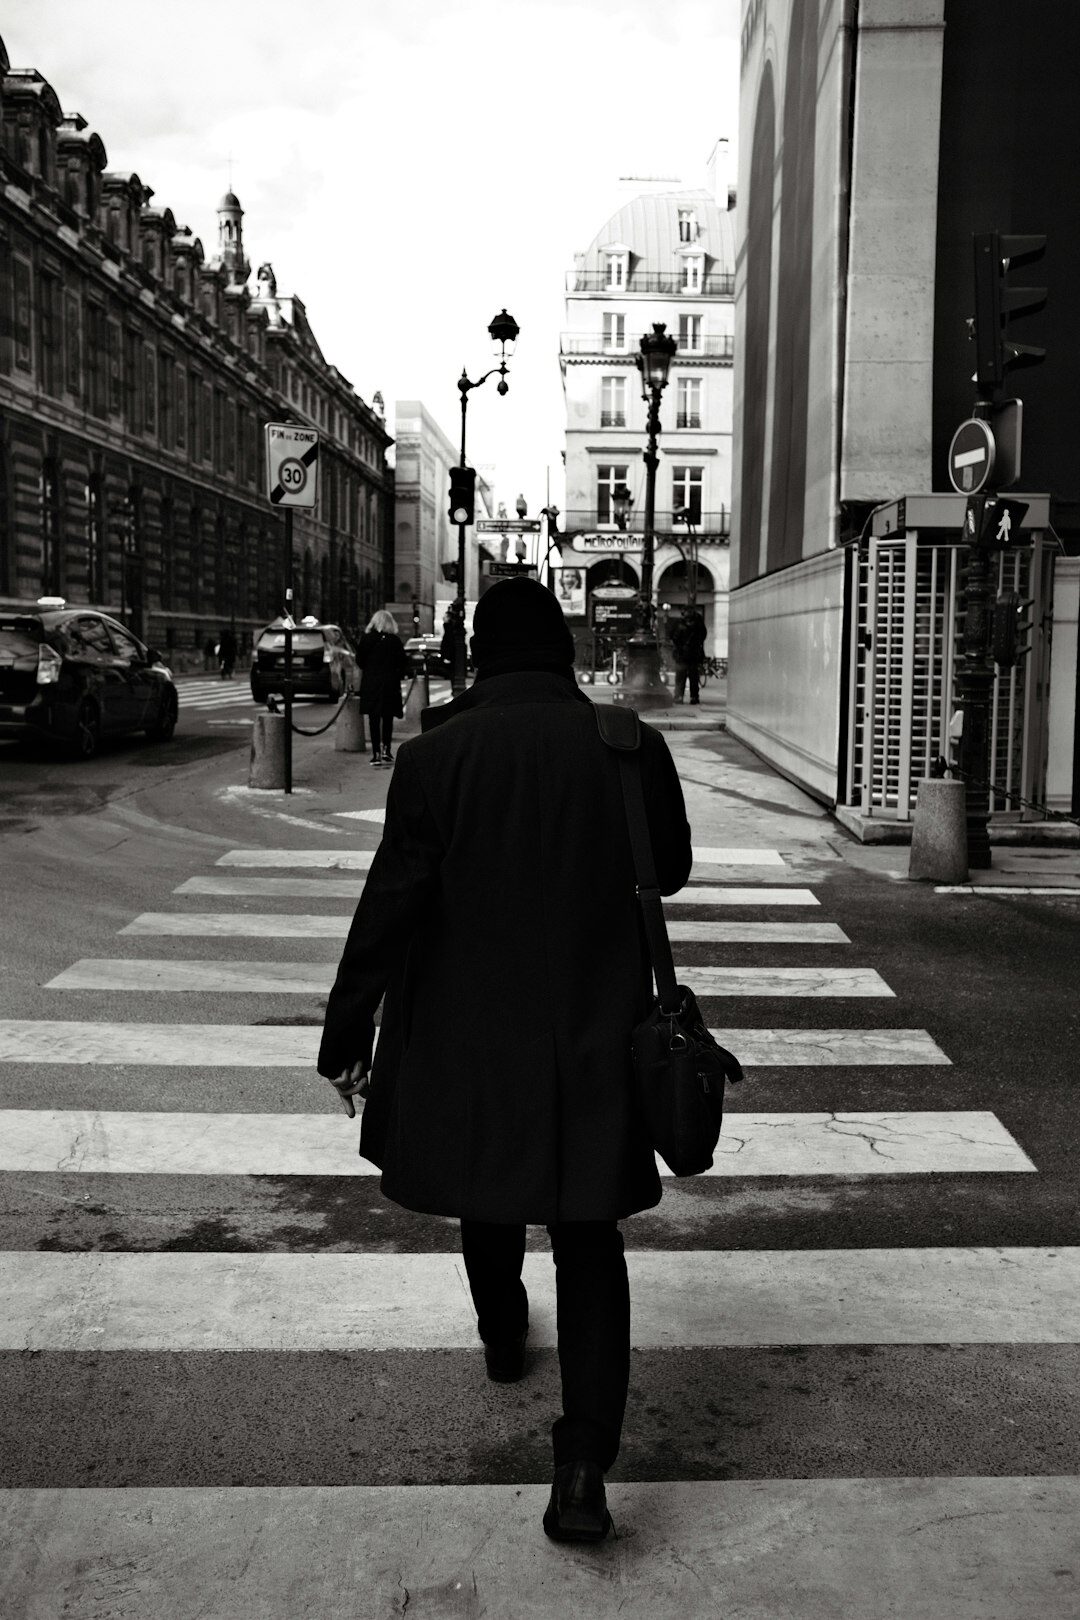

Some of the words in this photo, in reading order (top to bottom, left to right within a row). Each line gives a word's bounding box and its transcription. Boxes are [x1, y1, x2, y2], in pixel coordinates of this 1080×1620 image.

[271, 429, 285, 440] FIN
[294, 432, 315, 442] ZONE
[284, 468, 301, 484] 30
